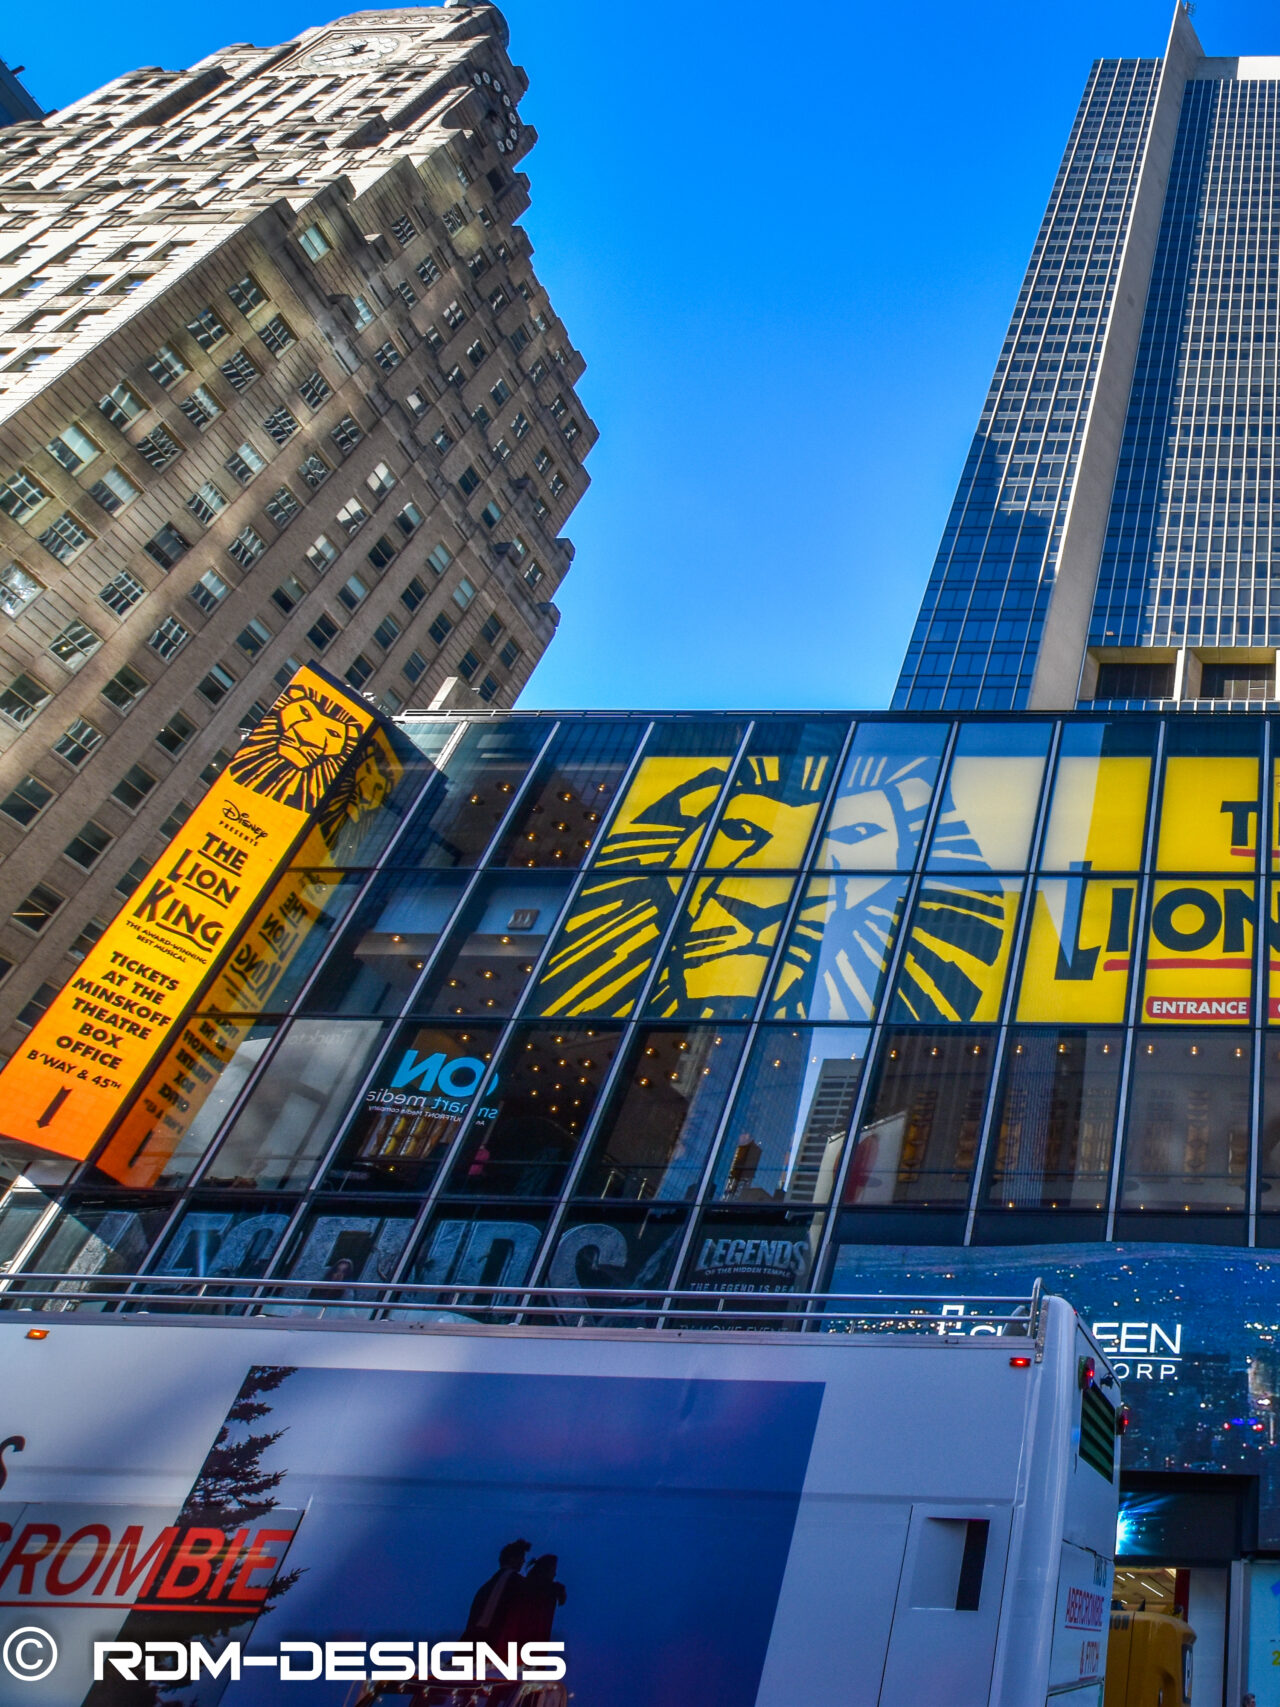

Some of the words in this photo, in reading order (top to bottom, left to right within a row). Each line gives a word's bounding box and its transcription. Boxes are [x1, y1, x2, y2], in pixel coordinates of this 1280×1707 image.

[202, 832, 248, 871] THE
[167, 848, 240, 903] LION
[133, 879, 224, 946] KING
[126, 920, 141, 932] THE
[142, 928, 207, 964] AWARD-WINNING
[136, 934, 154, 946] BEST
[153, 942, 187, 963] MUSICAL
[101, 970, 129, 987] AT
[131, 982, 165, 1005] THE
[110, 951, 180, 991] TICKETS
[71, 977, 172, 1027] MINSKOFF
[72, 997, 152, 1040] THEATRE
[1152, 1001, 1247, 1015] ENTRANCE
[56, 1035, 123, 1070] OFFICE
[78, 1022, 124, 1049] BOX
[27, 1049, 76, 1074] B'WAY
[77, 1069, 88, 1081] &
[92, 1075, 122, 1089] 45TH
[695, 1238, 809, 1276] LEGENDS
[1092, 1322, 1182, 1354] EEN
[1115, 1362, 1178, 1381] ORP.
[0, 1523, 294, 1601] ROMBIE
